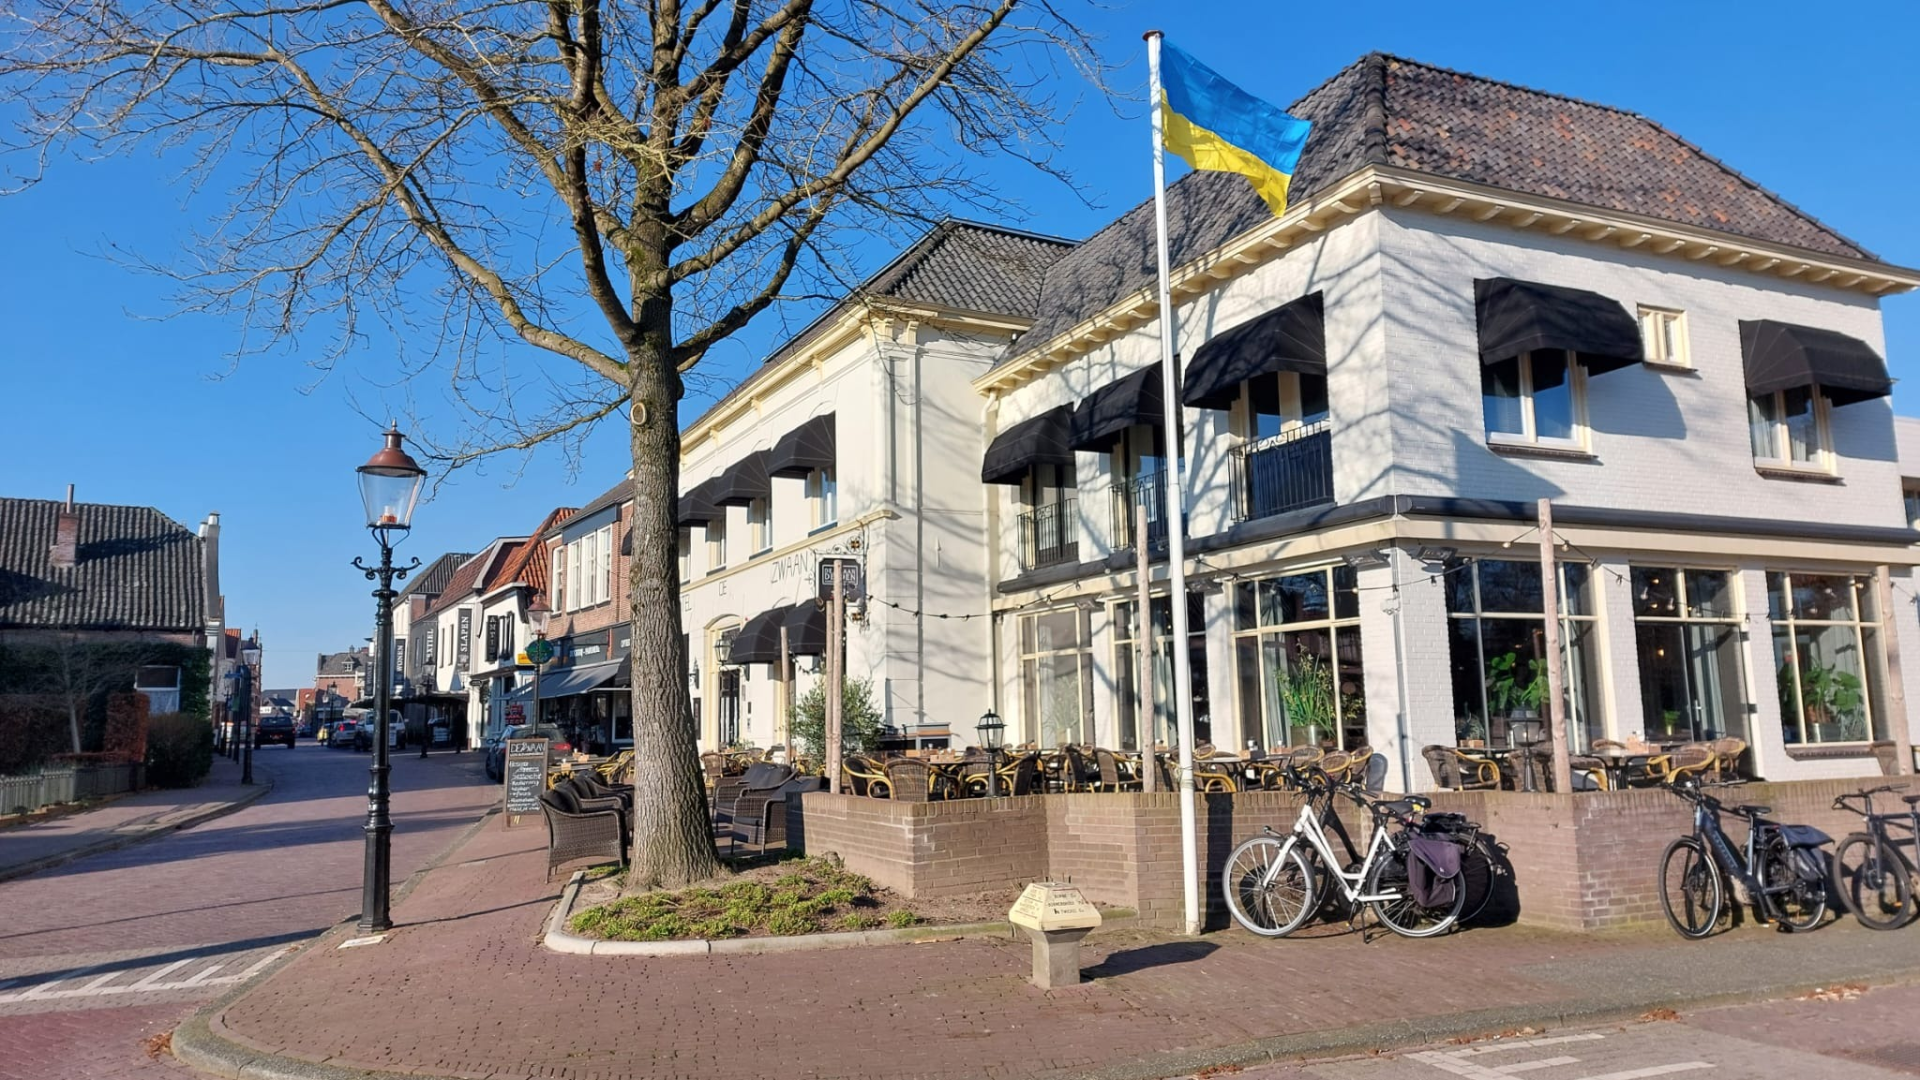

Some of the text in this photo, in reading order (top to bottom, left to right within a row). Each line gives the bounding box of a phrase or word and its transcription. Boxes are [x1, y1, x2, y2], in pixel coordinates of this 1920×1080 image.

[771, 550, 808, 584] ZWAAN
[460, 616, 469, 652] SLAPEN
[396, 645, 404, 672] WONEN
